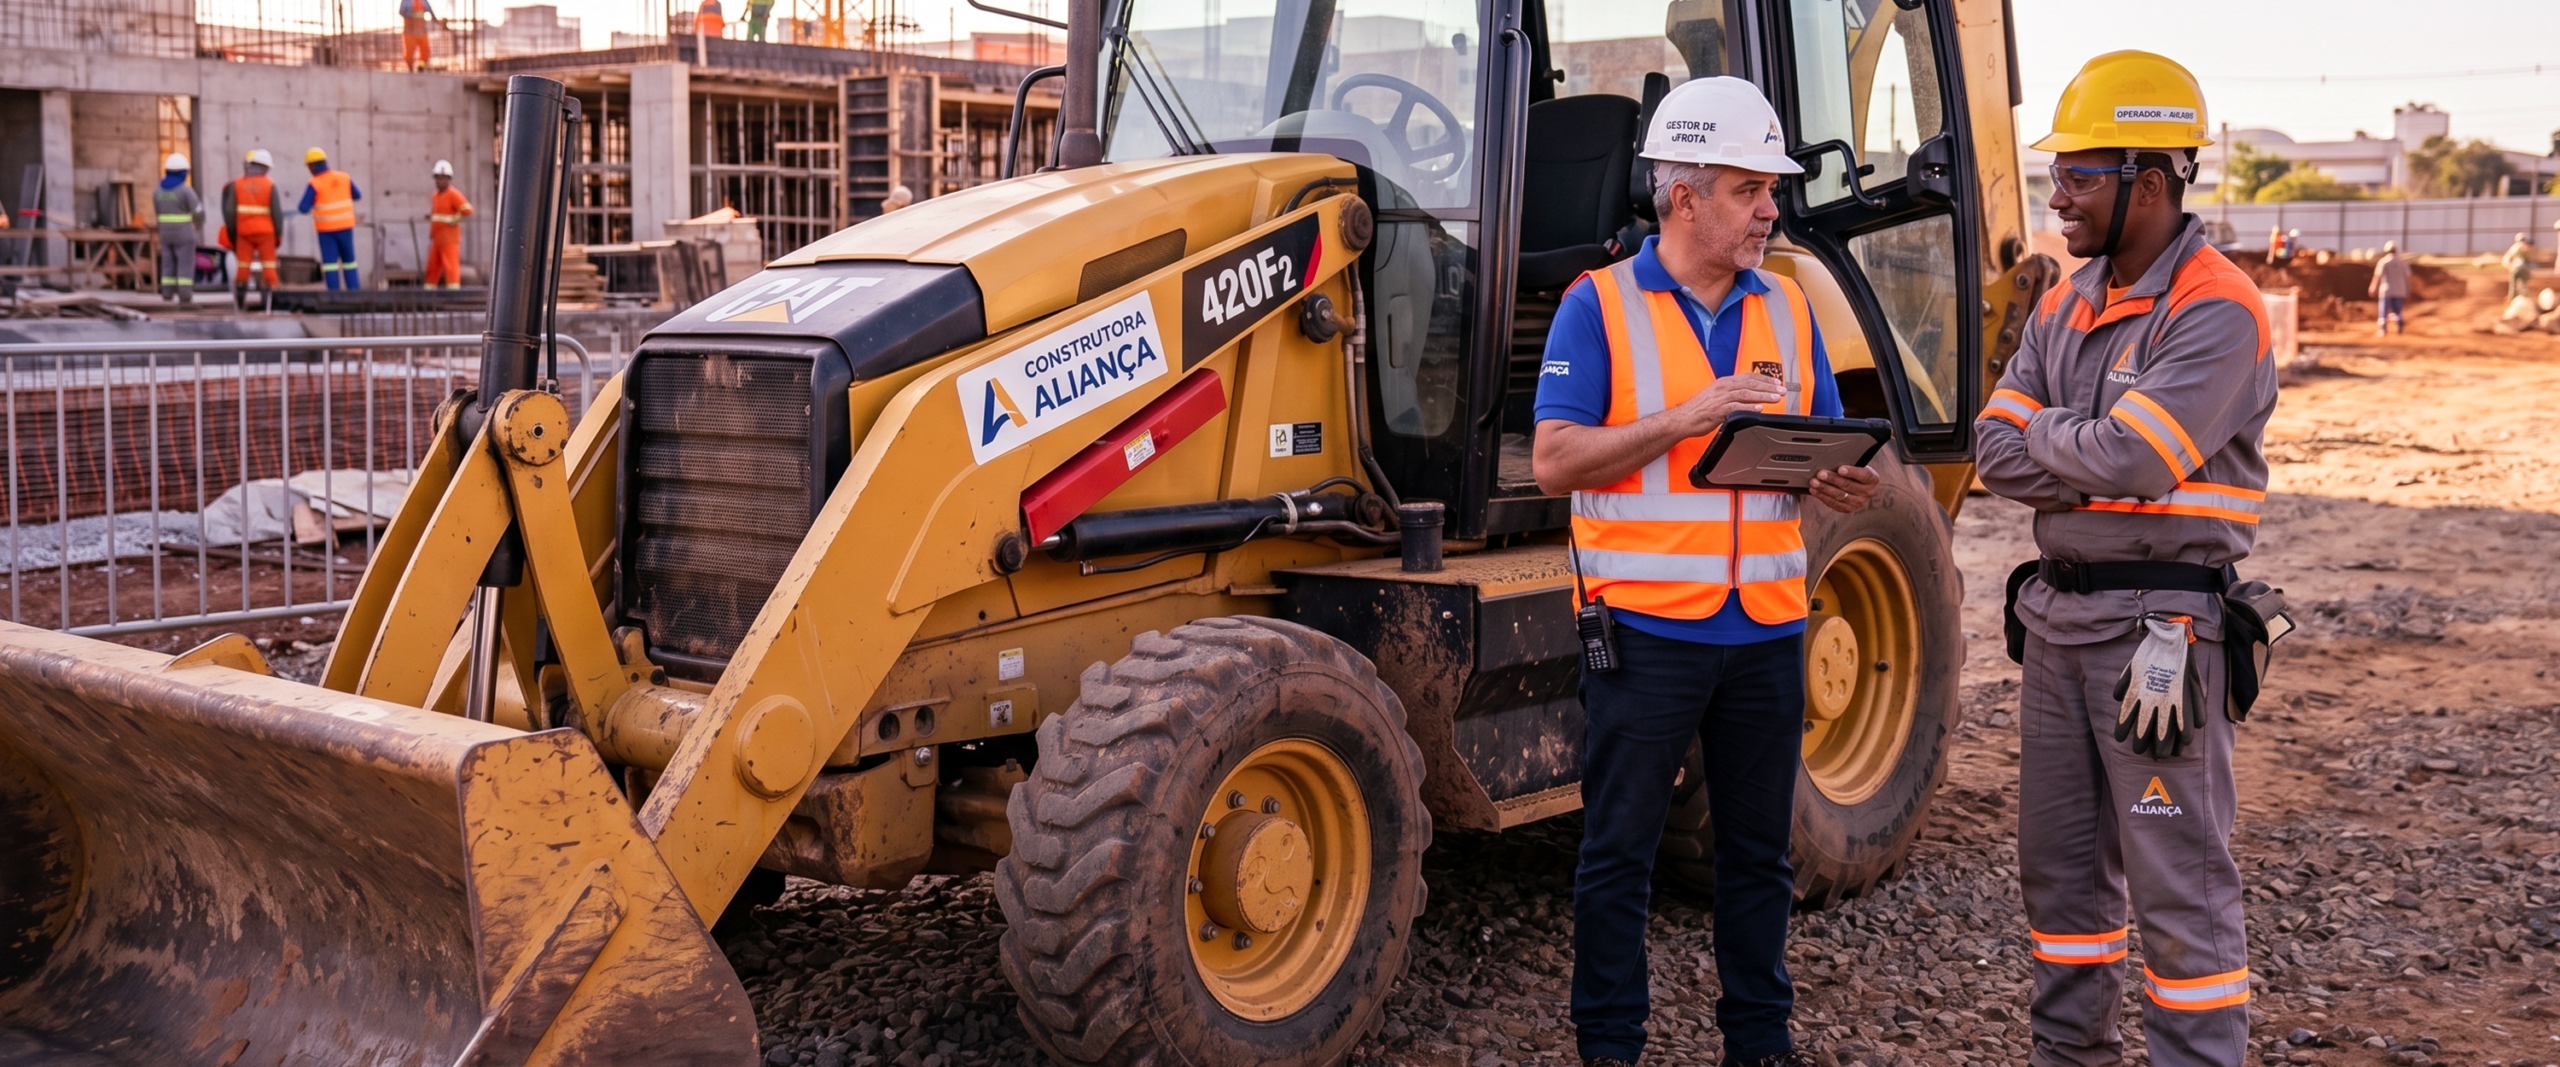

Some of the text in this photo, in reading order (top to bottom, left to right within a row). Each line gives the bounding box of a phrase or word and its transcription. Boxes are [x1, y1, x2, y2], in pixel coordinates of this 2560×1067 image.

[1666, 121, 1716, 132] GESTOR DE
[705, 277, 886, 324] CAT
[1202, 246, 1297, 326] 420F2
[1024, 310, 1147, 378] CONSTRUTORA
[1035, 335, 1157, 419] ALIANÇA
[2130, 804, 2183, 817] ALIANÇA
